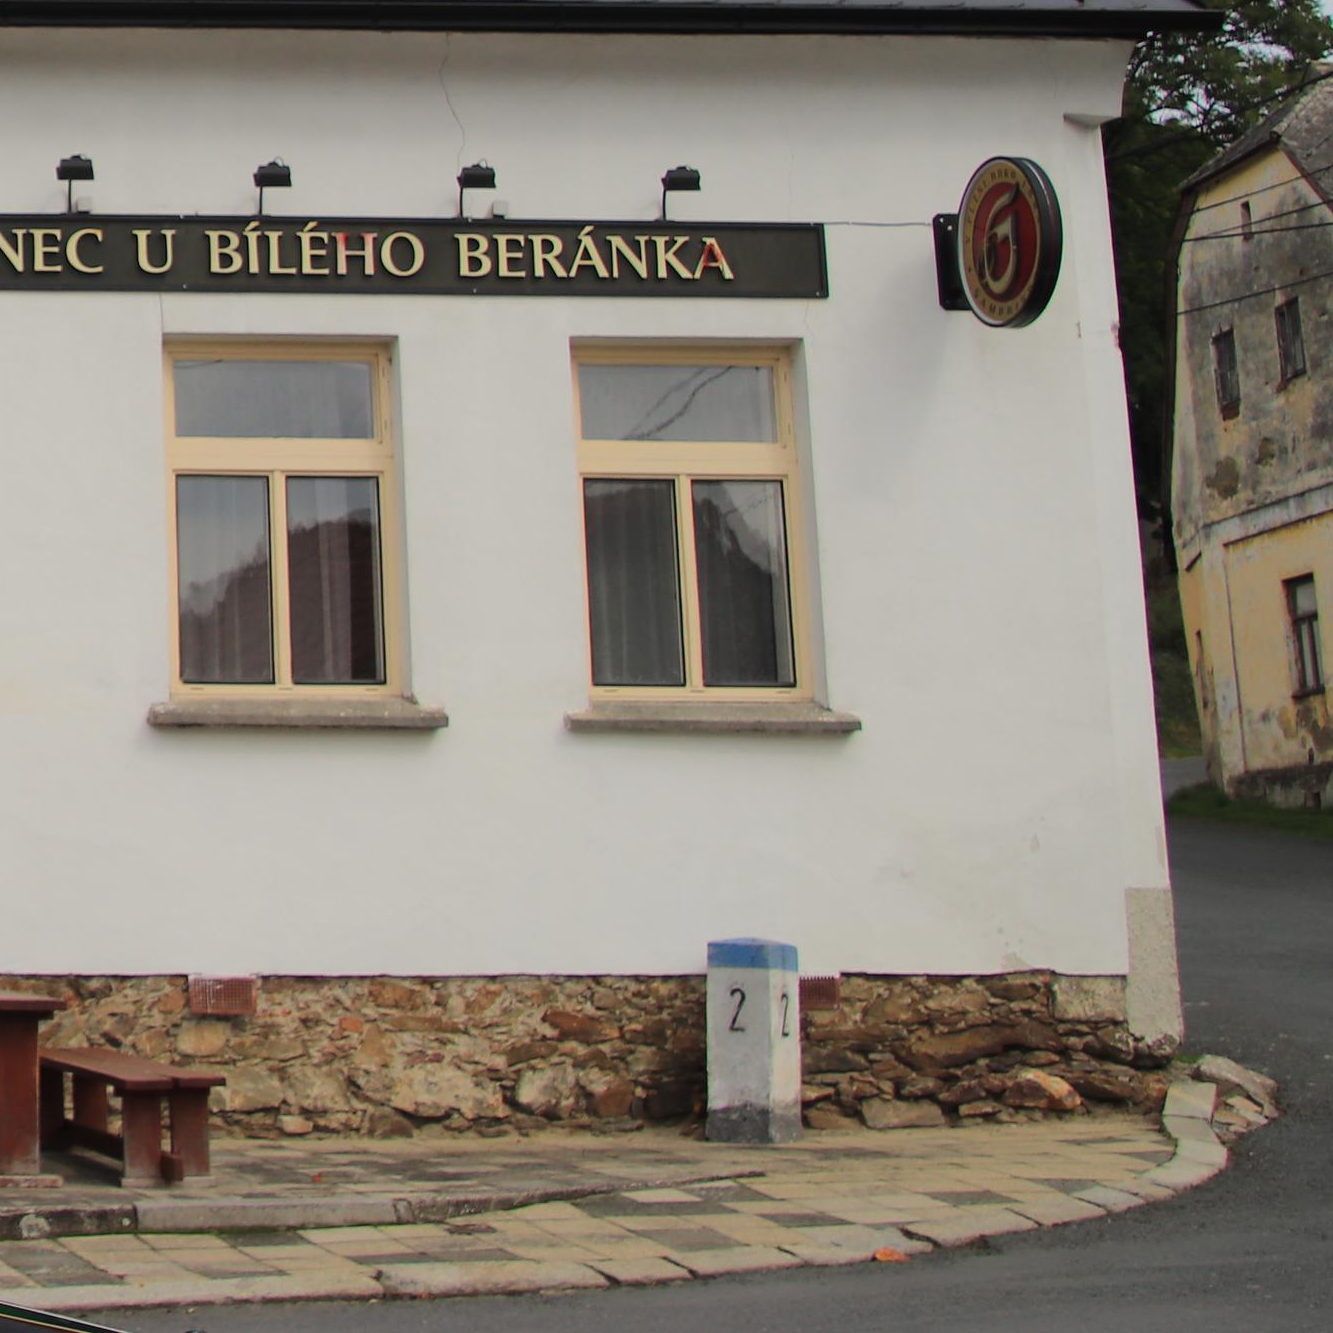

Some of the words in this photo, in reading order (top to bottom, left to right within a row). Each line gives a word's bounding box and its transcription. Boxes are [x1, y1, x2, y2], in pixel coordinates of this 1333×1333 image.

[132, 229, 176, 274] U
[204, 221, 425, 277] BÍLÉHO
[454, 225, 734, 280] BERÁNKA
[729, 988, 746, 1032] 2
